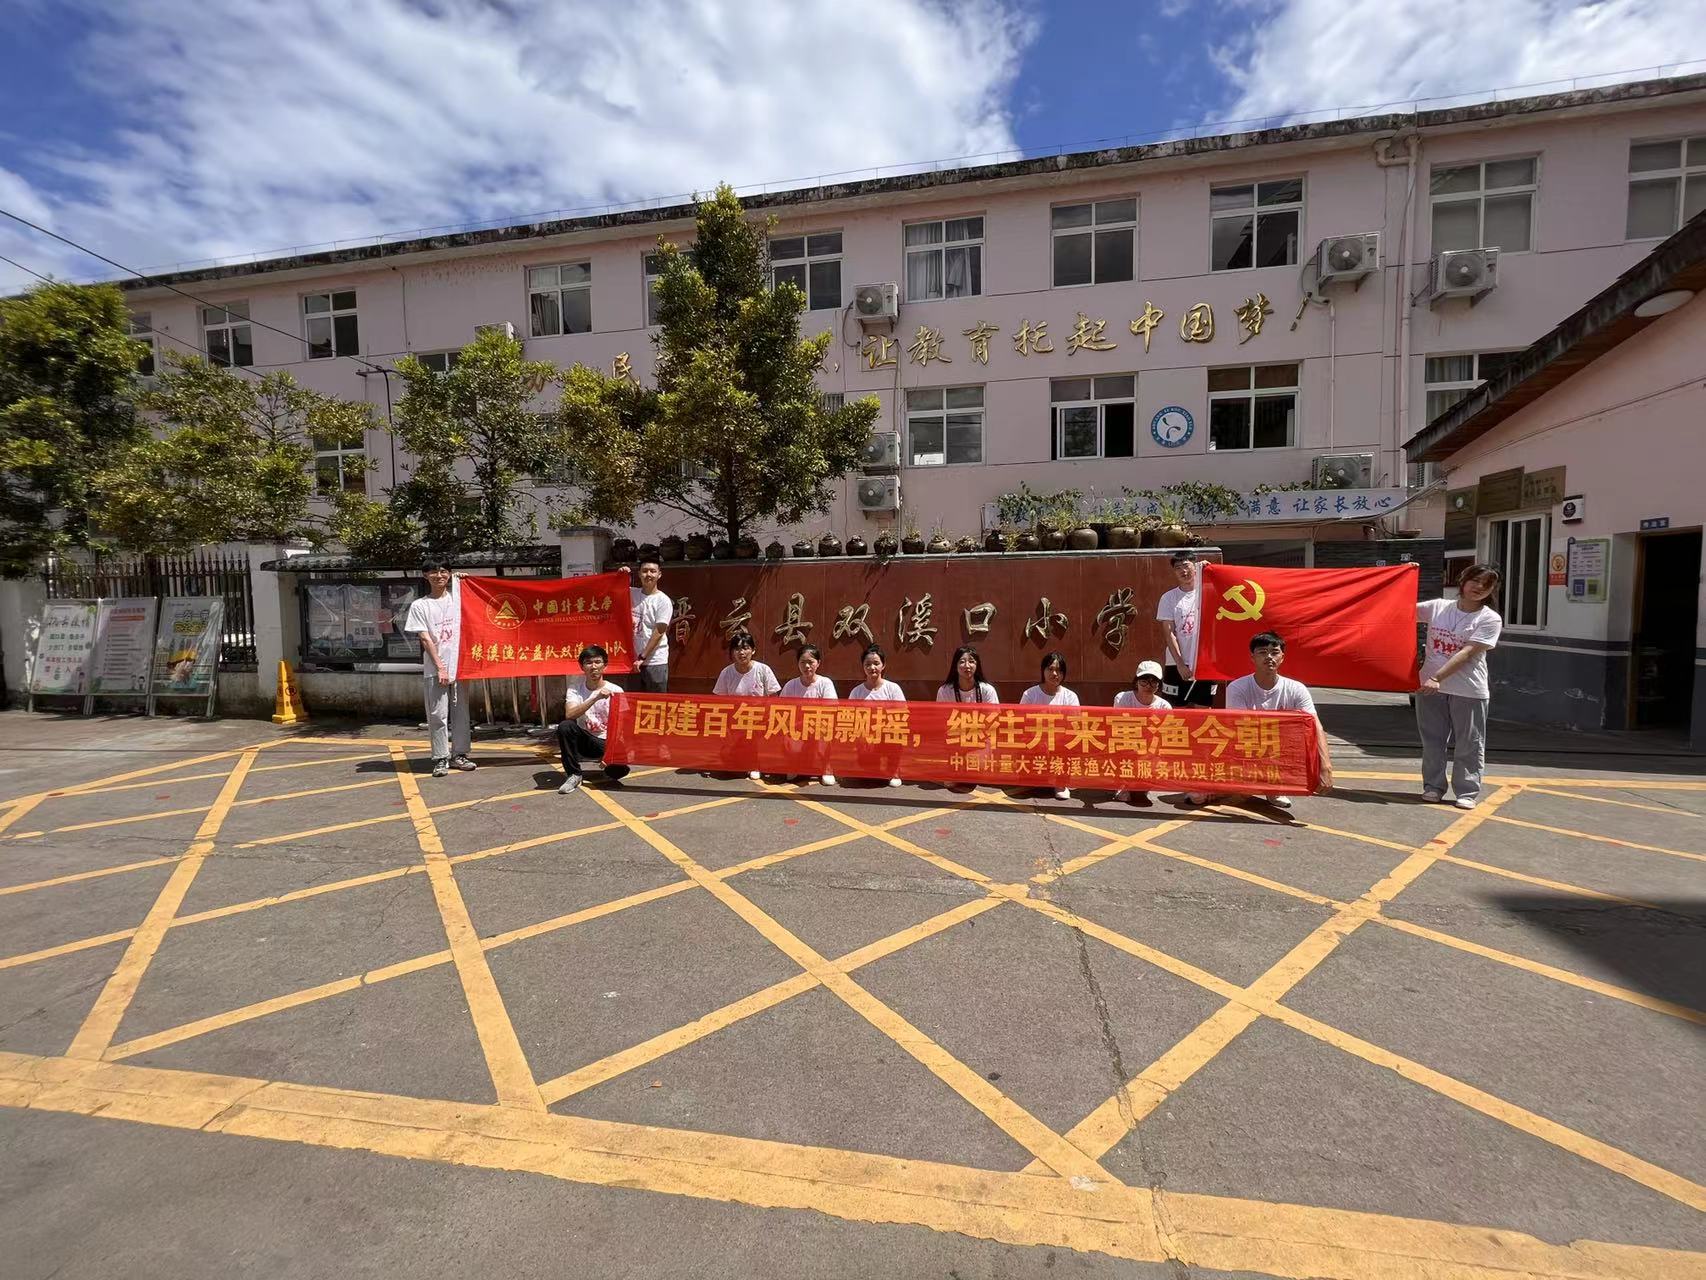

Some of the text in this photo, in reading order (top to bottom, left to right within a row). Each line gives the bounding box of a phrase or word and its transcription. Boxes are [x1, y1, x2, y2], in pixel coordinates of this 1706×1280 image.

[1293, 495, 1392, 515] 让家长放心
[533, 595, 613, 616] 中国计量大学
[471, 640, 627, 663] 缘溪渔公益队双溪小队
